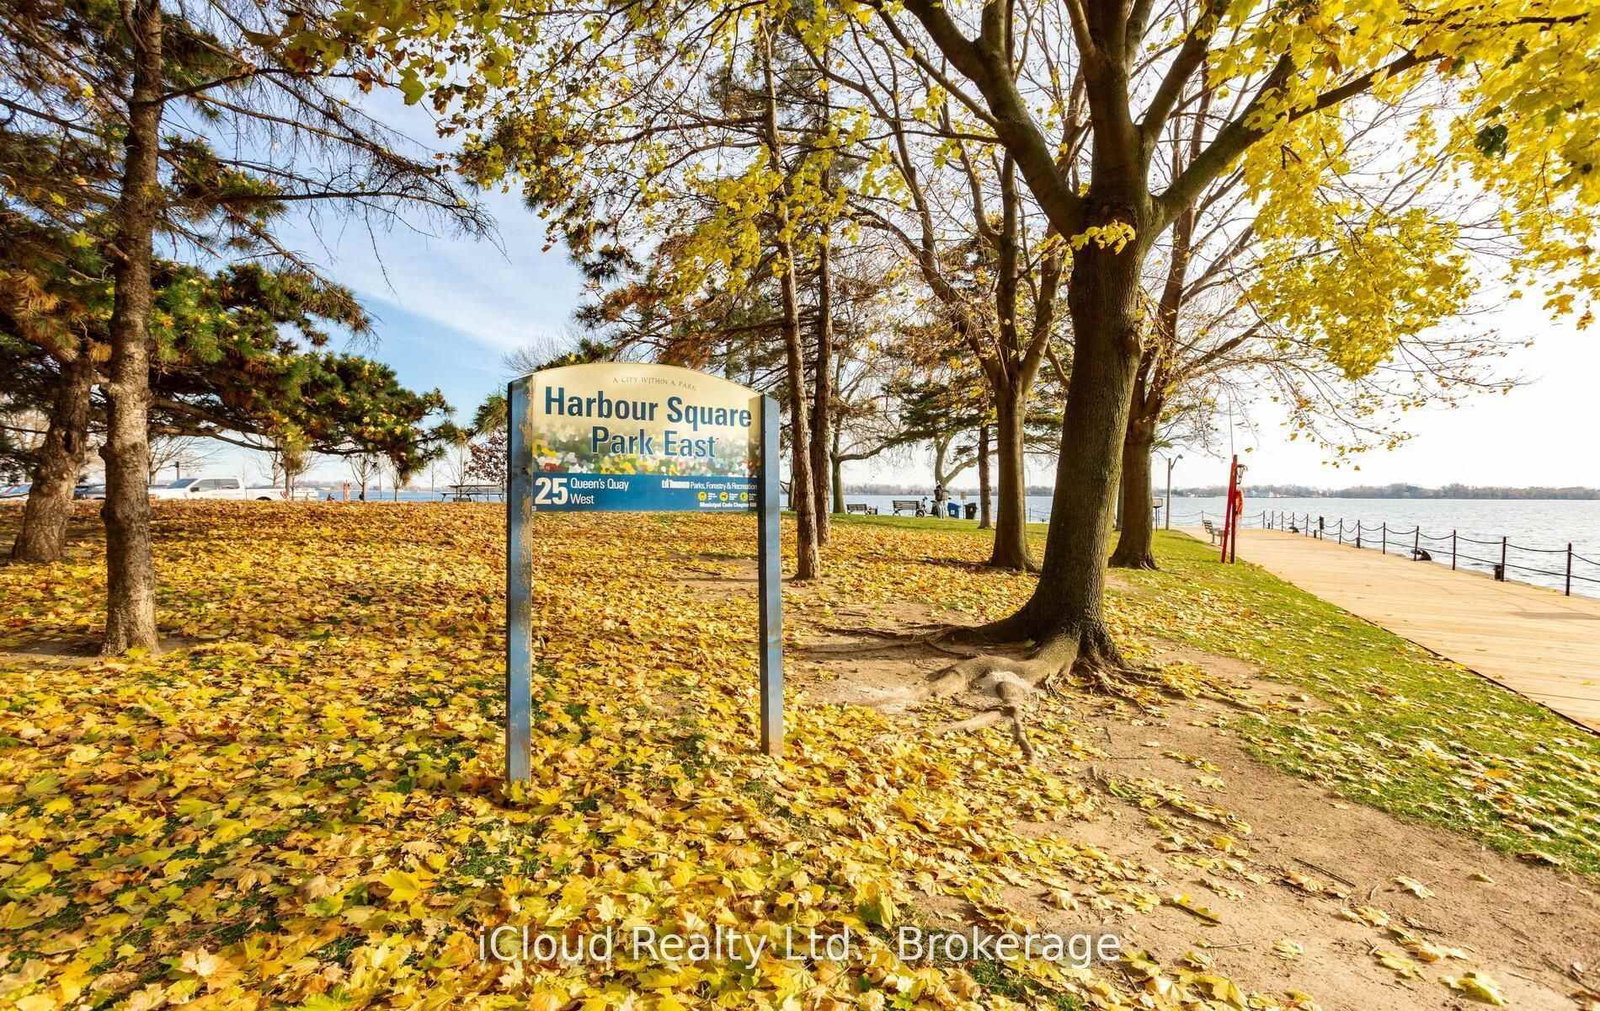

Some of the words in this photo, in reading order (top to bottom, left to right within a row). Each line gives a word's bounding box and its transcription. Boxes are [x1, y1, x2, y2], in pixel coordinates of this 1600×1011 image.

[621, 377, 638, 385] CITY
[641, 377, 668, 386] WITHIN
[678, 381, 697, 391] PARK
[545, 386, 659, 422] Harbour
[667, 396, 752, 431] Square
[591, 425, 653, 456] Park
[663, 430, 716, 458] East
[534, 477, 569, 505] 25
[570, 477, 606, 489] Queen's
[607, 478, 630, 491] Quay
[705, 482, 726, 491] Forestry
[731, 483, 758, 491] Recreation
[570, 493, 595, 505] West
